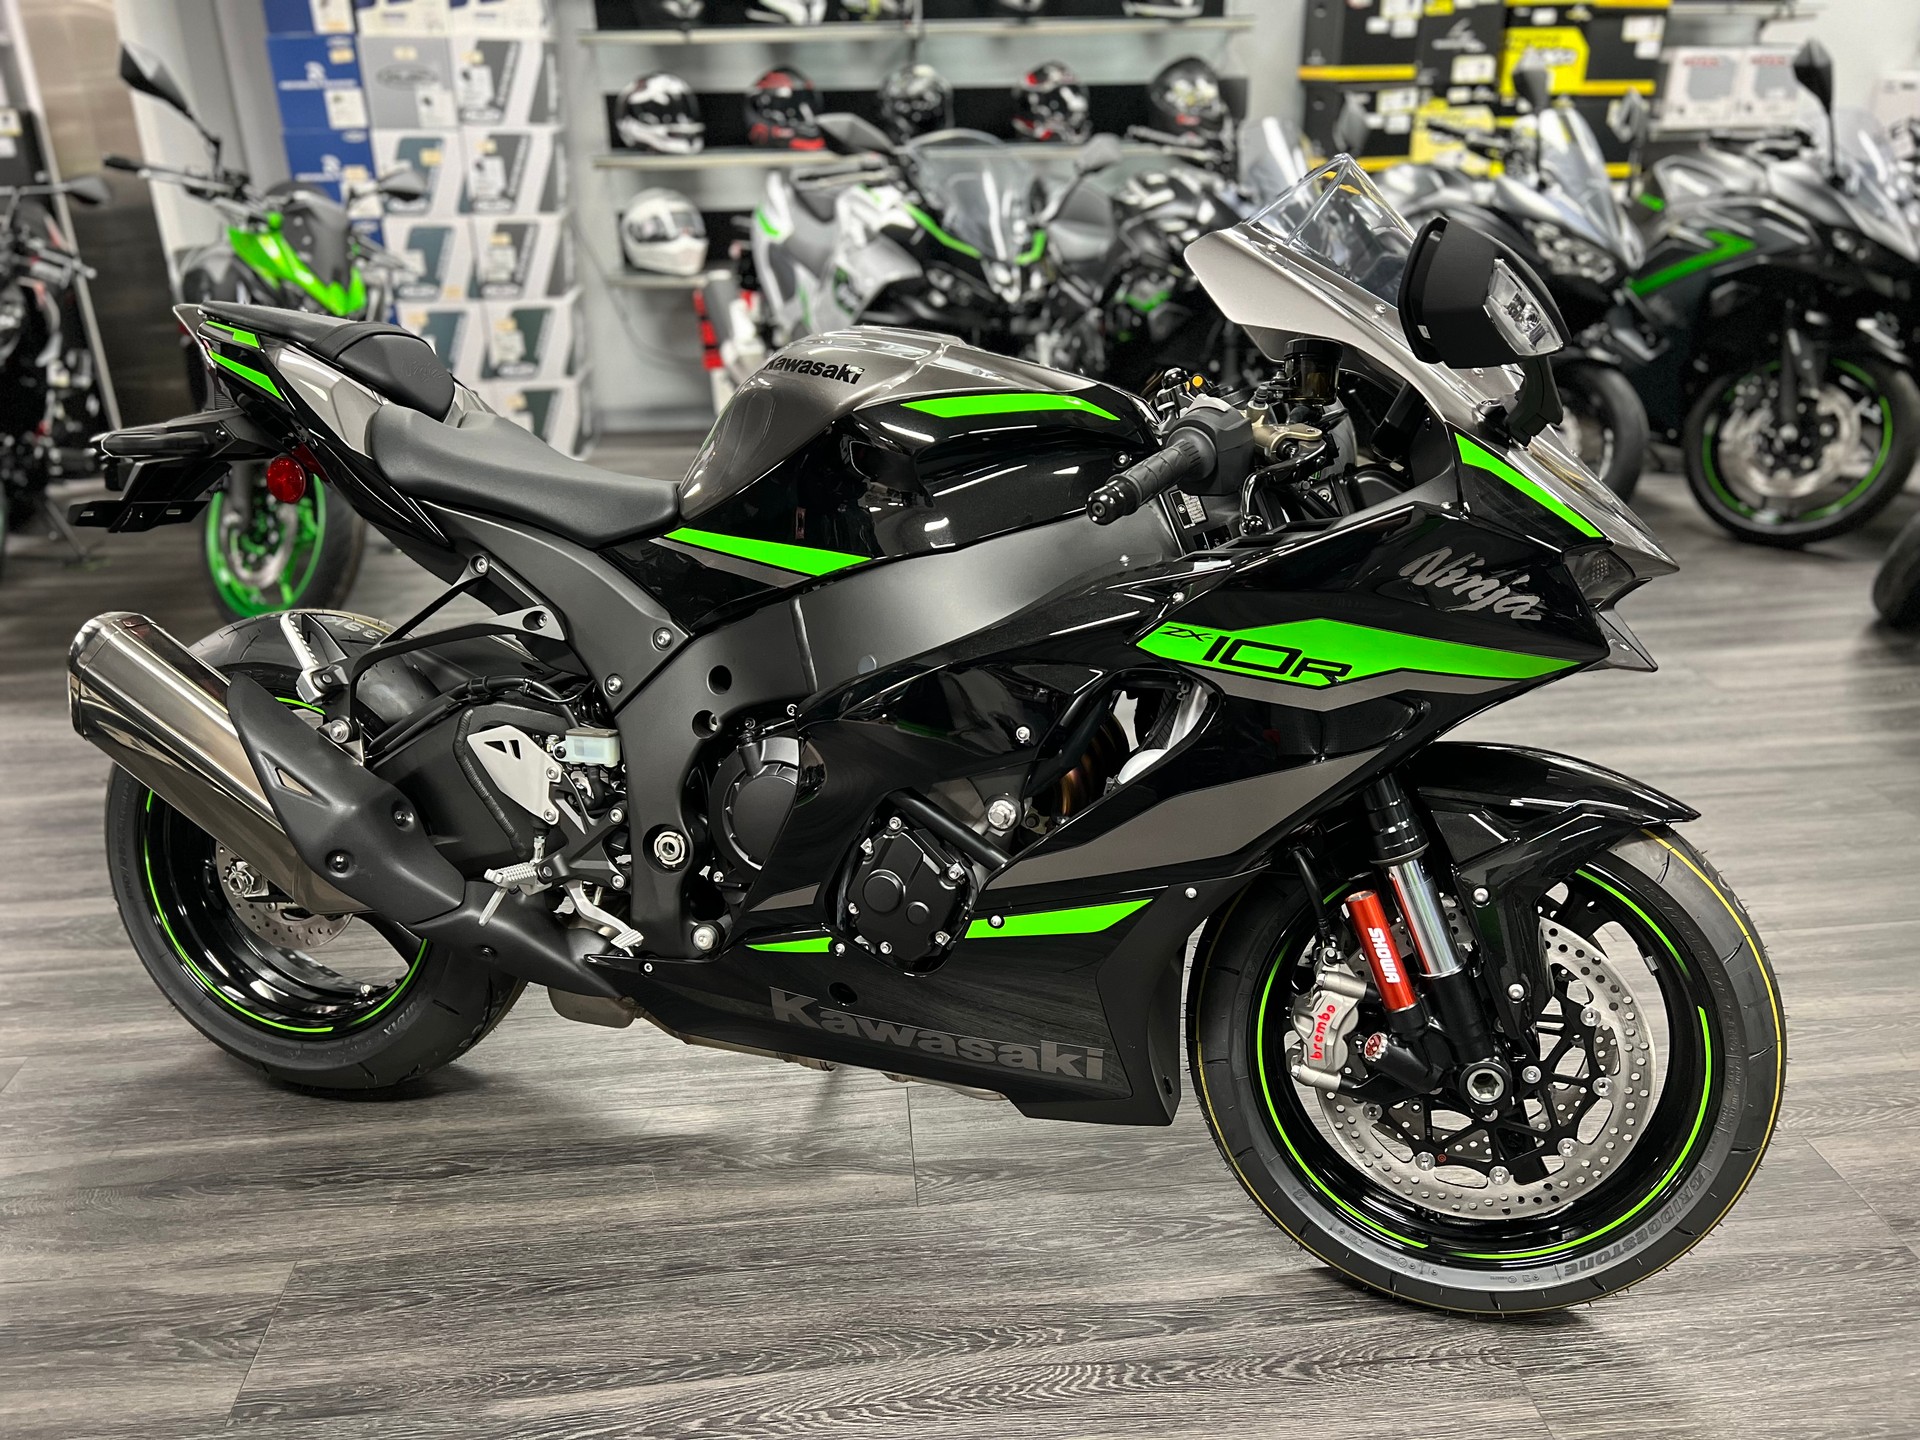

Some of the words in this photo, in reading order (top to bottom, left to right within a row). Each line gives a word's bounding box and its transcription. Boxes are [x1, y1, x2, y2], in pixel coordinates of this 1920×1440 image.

[763, 355, 865, 385] Kawasaki
[1398, 546, 1541, 620] Ninja
[1367, 927, 1401, 983] SHOWA
[769, 987, 1105, 1080] Kawasaki
[1310, 1004, 1336, 1060] brembo
[1564, 1168, 1706, 1277] BRIDGESTONE
